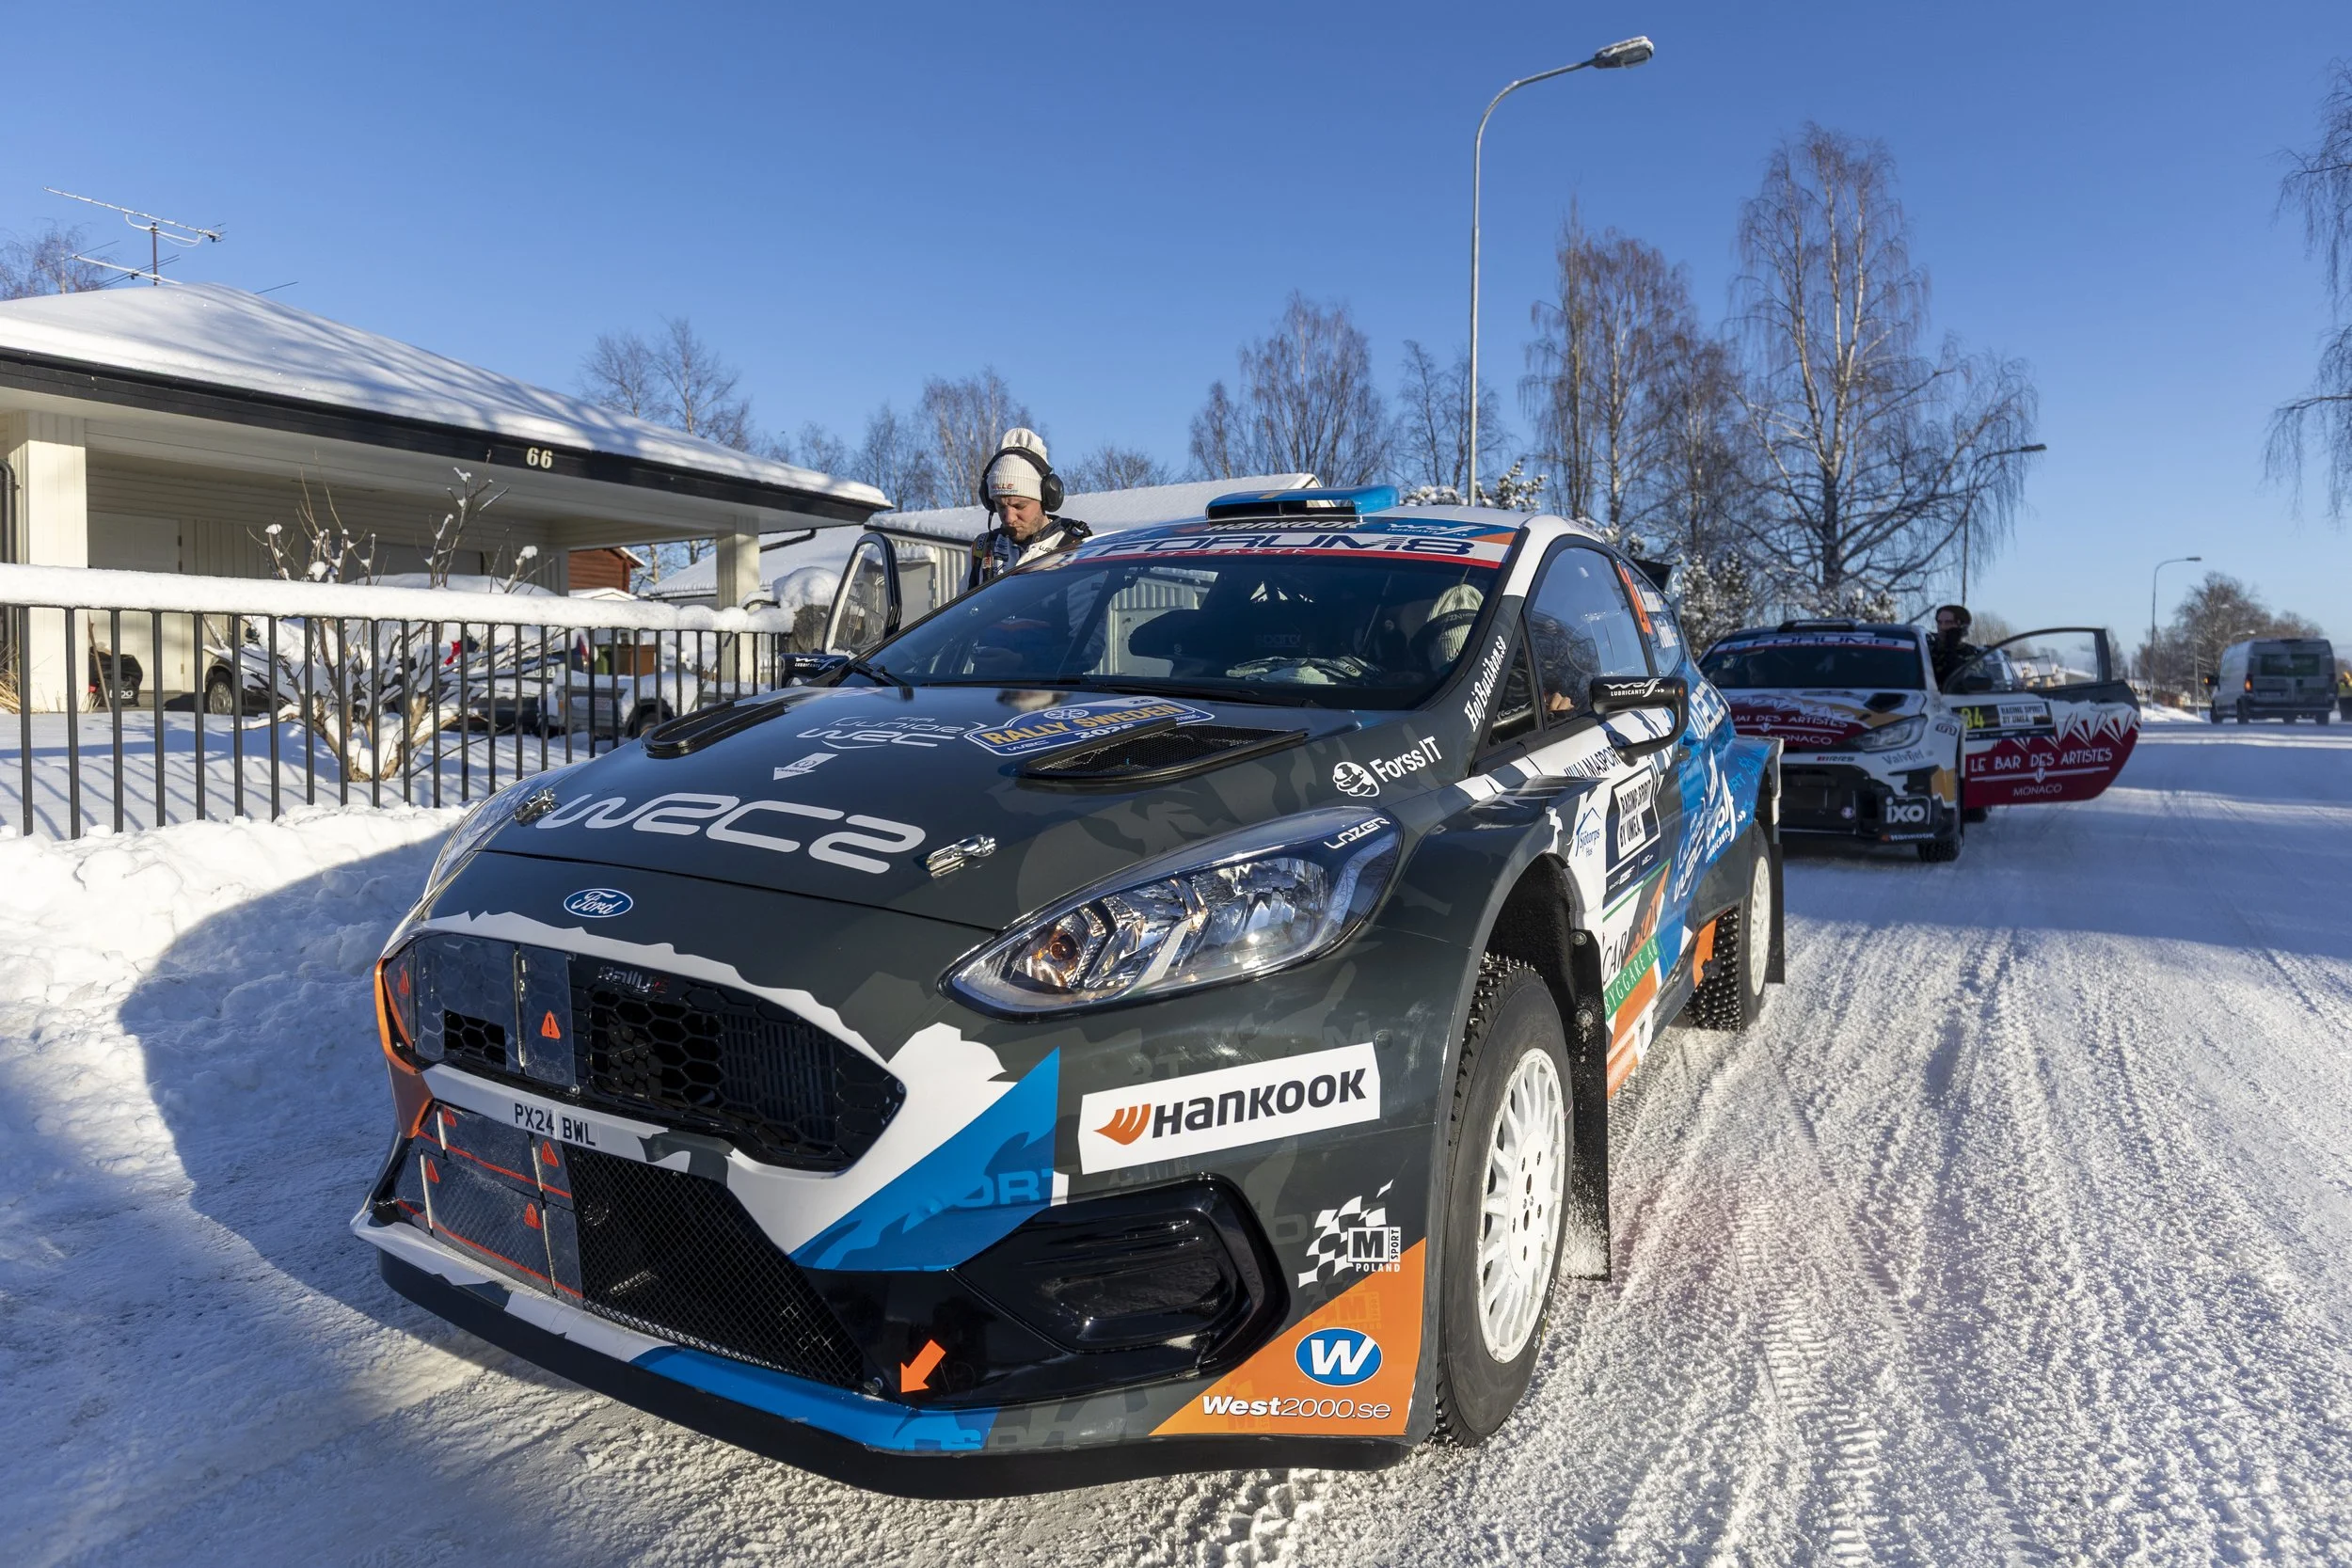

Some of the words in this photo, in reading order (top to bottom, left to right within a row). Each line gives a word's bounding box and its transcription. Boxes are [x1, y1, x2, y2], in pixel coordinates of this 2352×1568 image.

[526, 447, 553, 469] 66
[1095, 532, 1475, 557] FORUM8
[1610, 689, 1645, 697] LUBRICANTS
[980, 721, 1072, 746] RALLY
[1072, 704, 1187, 729] SWEDEN
[1788, 715, 1848, 728] ARTISTES
[795, 727, 957, 748] WRC
[1369, 749, 1426, 783] Forss
[1418, 736, 1442, 764] IT
[1970, 757, 1986, 772] LE
[1994, 755, 2022, 770] BAR
[2029, 752, 2056, 768] DES
[2060, 747, 2113, 766] ARTISTES
[2012, 784, 2063, 797] MONACO
[1885, 797, 1925, 824] ixo
[534, 792, 927, 874] WRC2
[1323, 816, 1391, 849] LAZER
[570, 890, 625, 915] Ford
[1603, 953, 1646, 1016] BYGGARE
[1646, 938, 1659, 960] AB
[1152, 1067, 1367, 1139] HANKOOK
[514, 1102, 555, 1135] PX24
[562, 1117, 596, 1147] BWL
[1352, 1230, 1384, 1259] M
[1391, 1228, 1400, 1260] SPORT
[1355, 1262, 1401, 1273] POLAND
[1310, 1336, 1377, 1376] W
[1202, 1395, 1392, 1419] West2000.se
